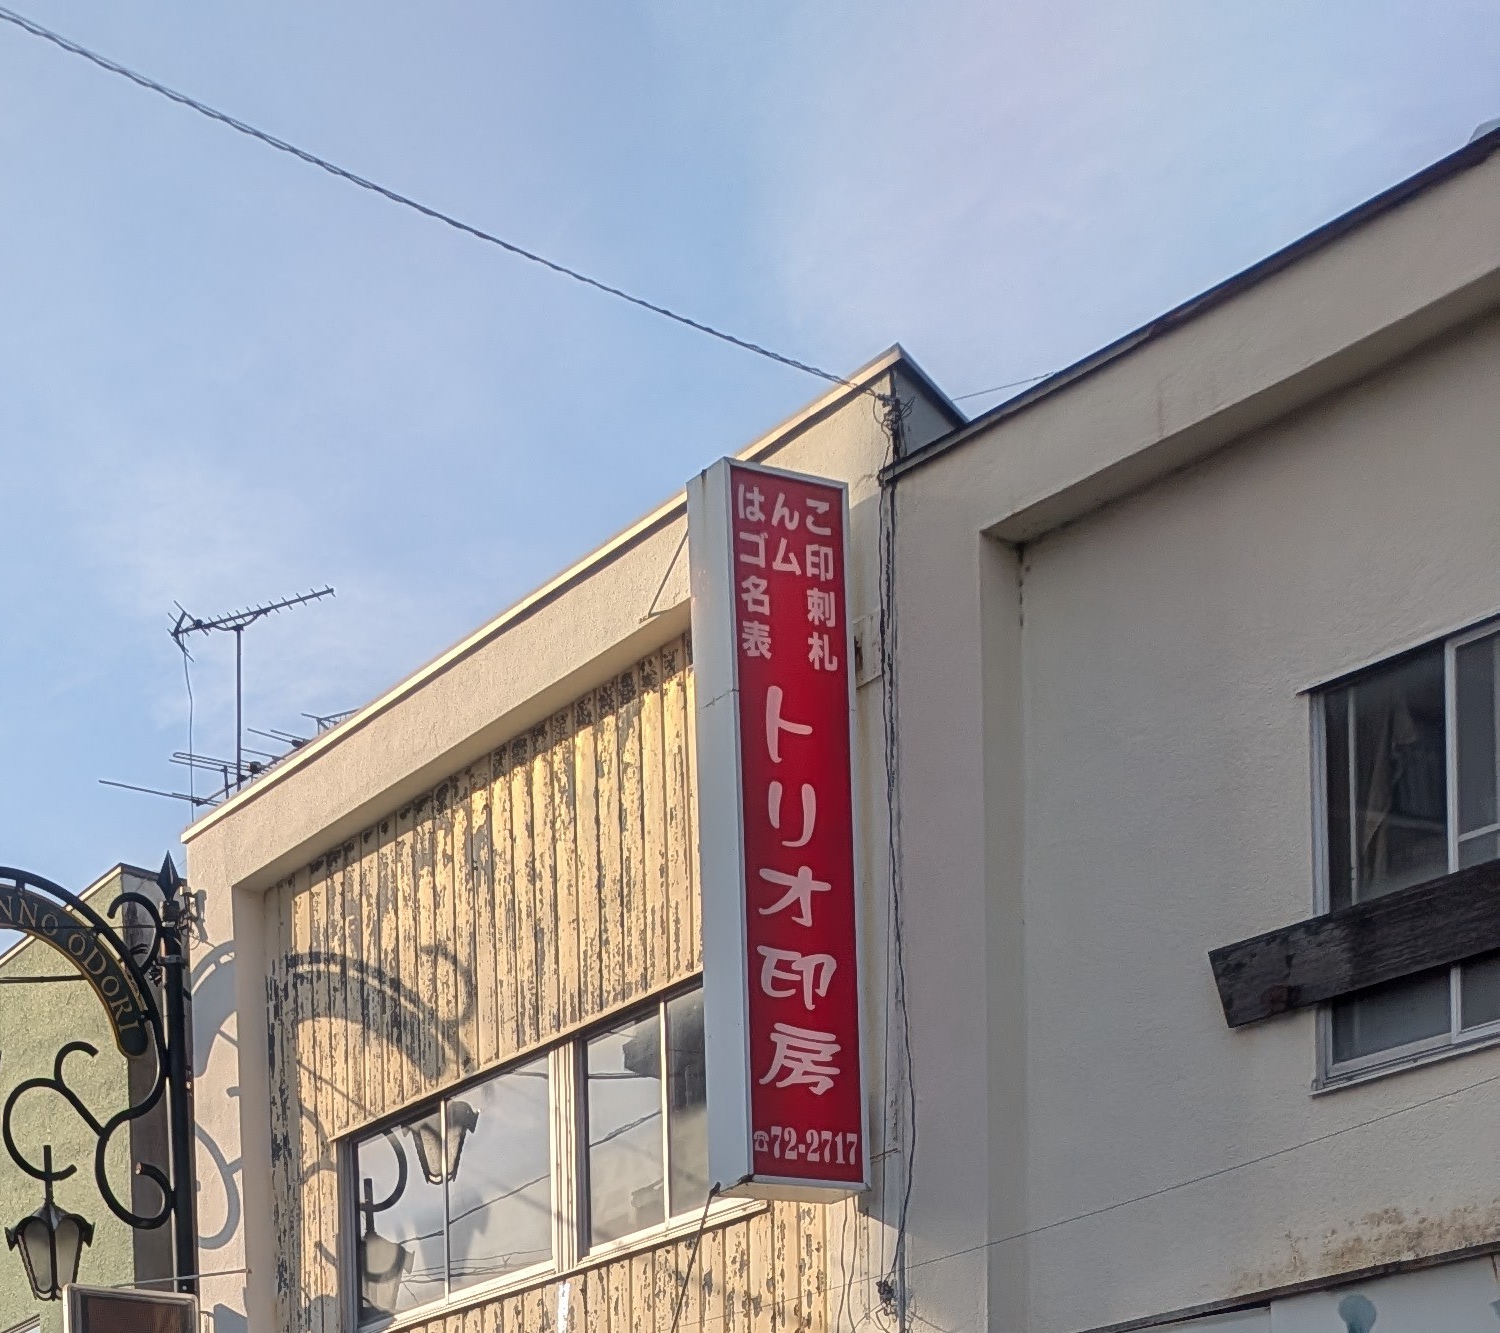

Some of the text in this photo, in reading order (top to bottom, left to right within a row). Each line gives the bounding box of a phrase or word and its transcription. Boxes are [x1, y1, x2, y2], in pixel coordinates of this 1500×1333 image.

[738, 484, 832, 536] はんこ
[739, 531, 834, 582] ゴム印
[741, 575, 836, 628] 名刺
[742, 620, 838, 672] 表札
[757, 685, 841, 1096] トリオ印房
[68, 932, 140, 1032] ODORI
[770, 1126, 858, 1165] 72-2717
